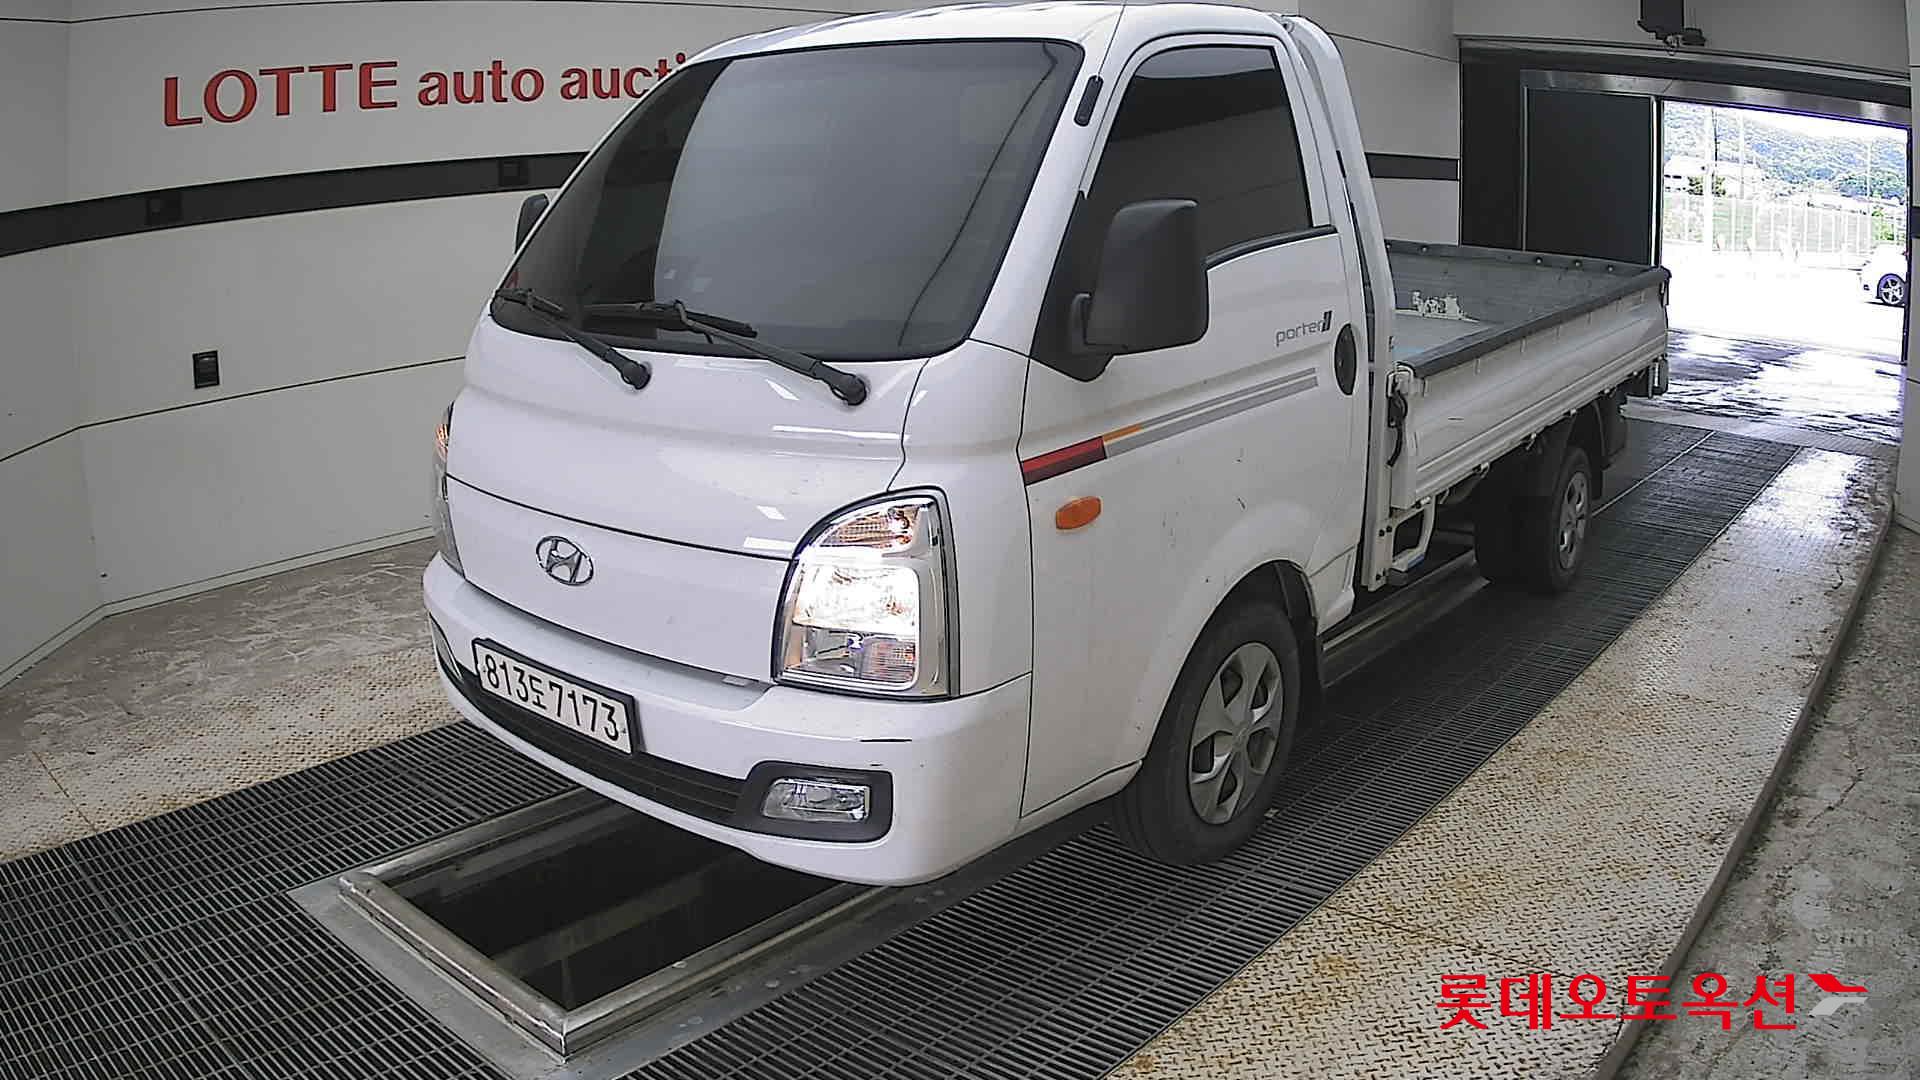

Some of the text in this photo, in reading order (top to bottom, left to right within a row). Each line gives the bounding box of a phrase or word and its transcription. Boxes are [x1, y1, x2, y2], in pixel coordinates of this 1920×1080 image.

[163, 52, 686, 127] LOTTE auto auct
[485, 654, 619, 742] 813도7173
